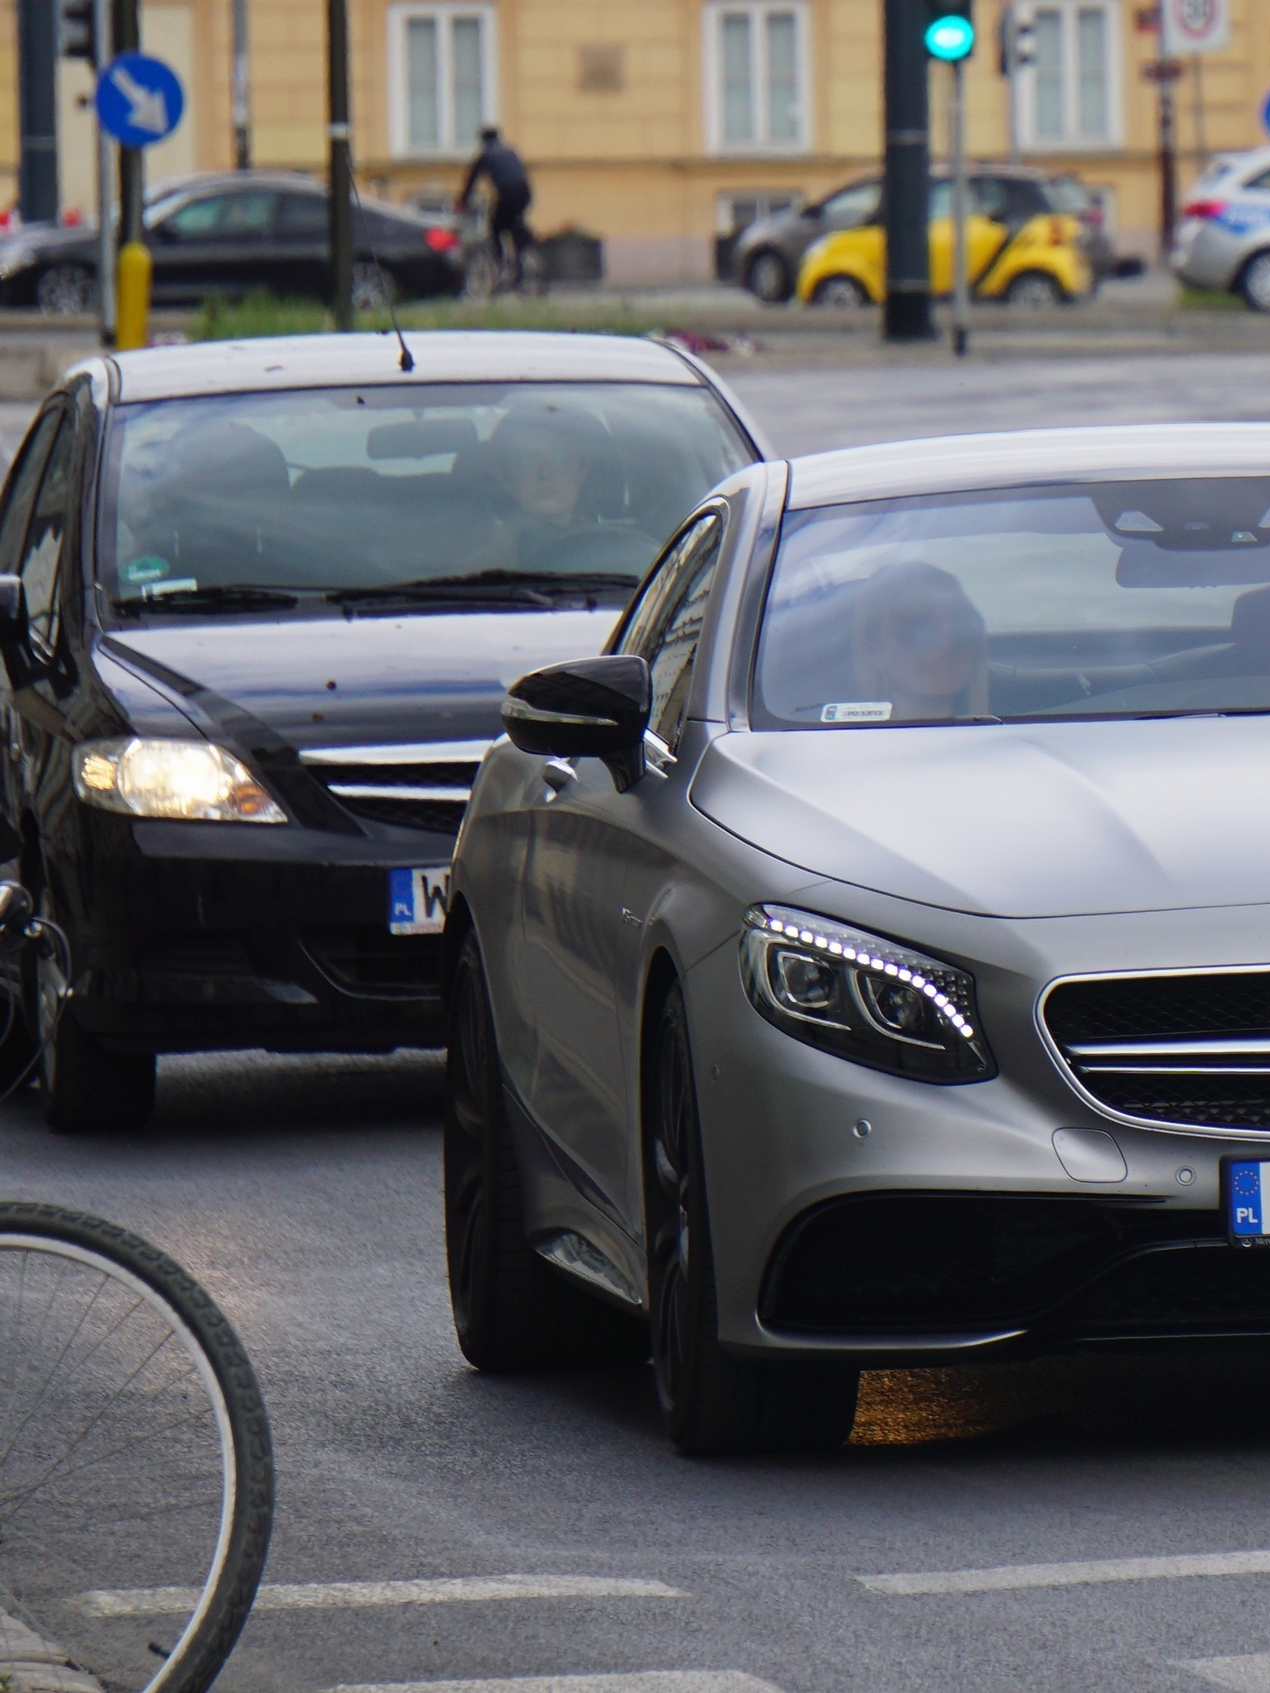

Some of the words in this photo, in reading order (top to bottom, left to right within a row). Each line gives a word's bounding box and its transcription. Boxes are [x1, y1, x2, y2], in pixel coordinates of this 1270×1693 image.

[421, 874, 450, 918] W
[394, 902, 412, 916] PL
[1236, 1207, 1259, 1224] PL
